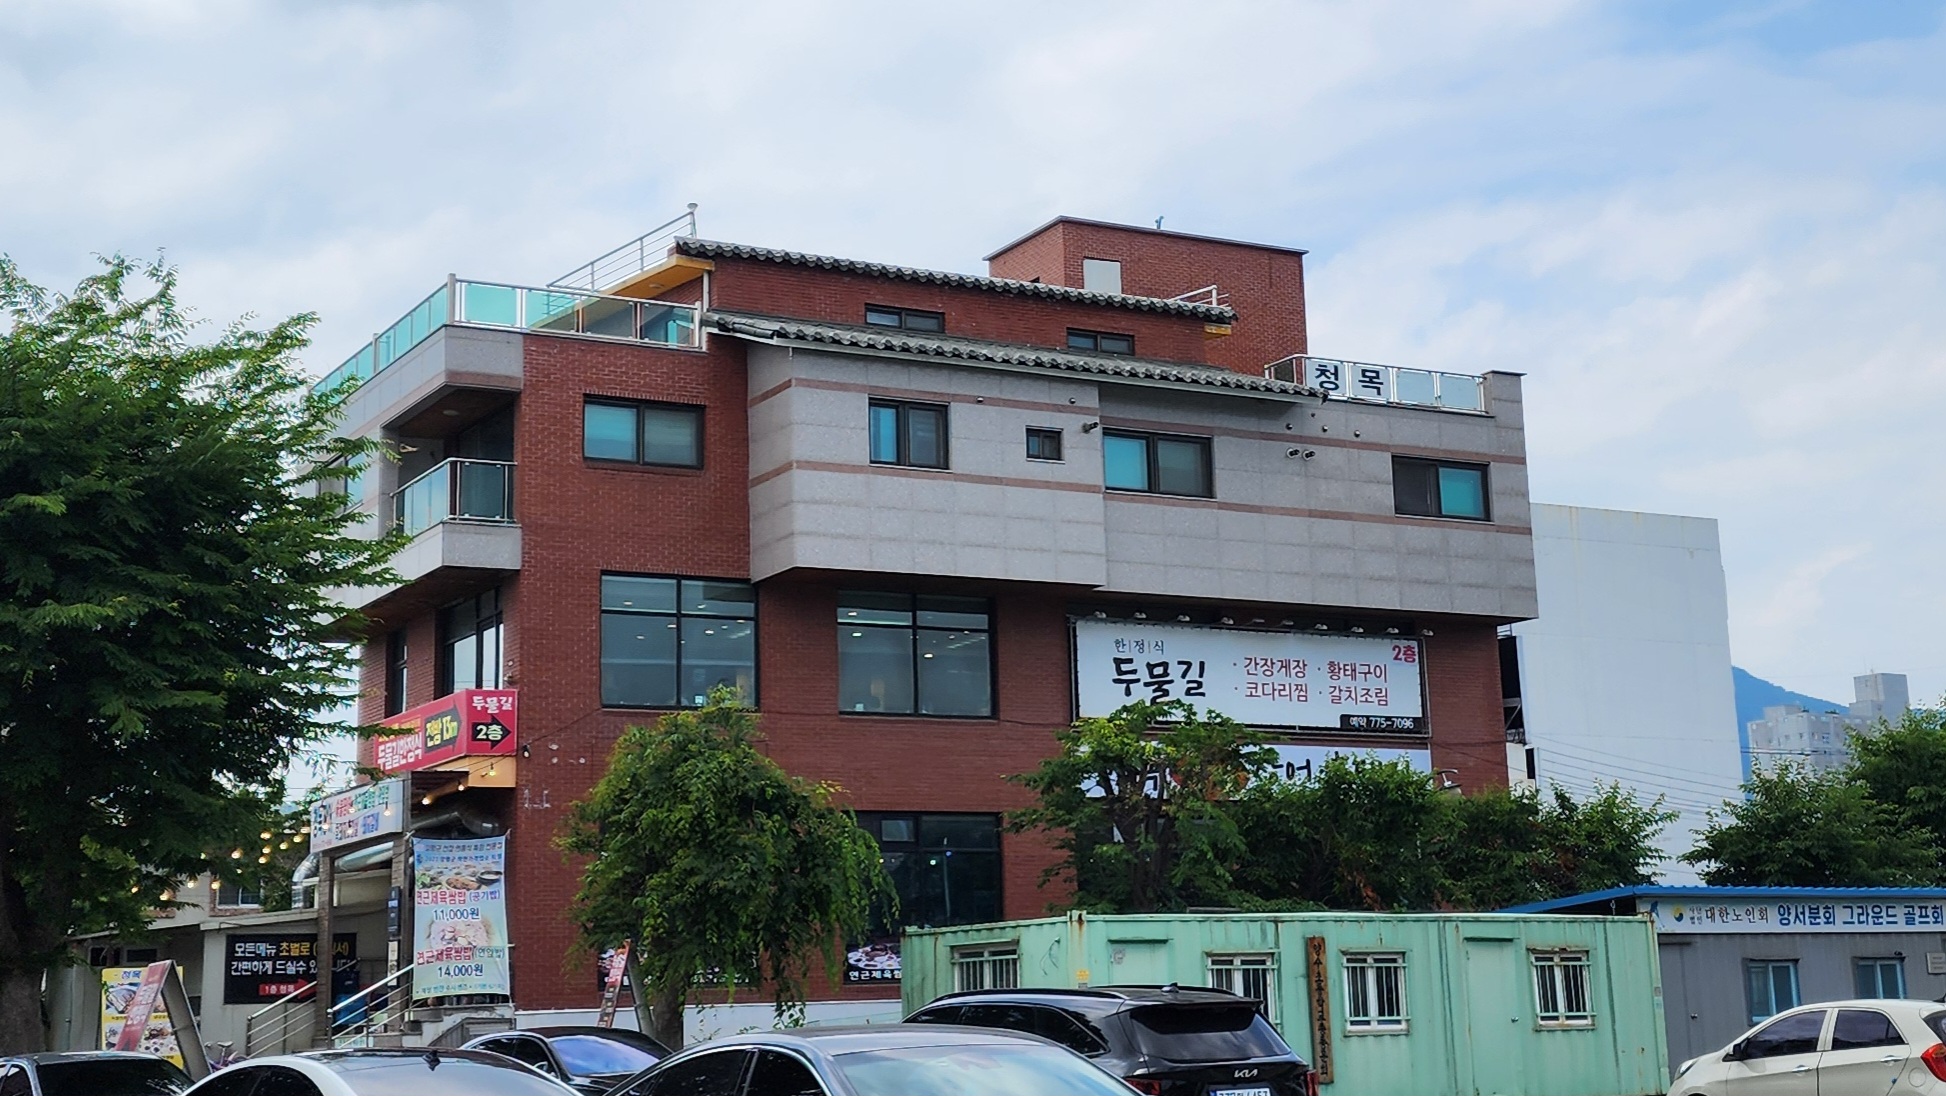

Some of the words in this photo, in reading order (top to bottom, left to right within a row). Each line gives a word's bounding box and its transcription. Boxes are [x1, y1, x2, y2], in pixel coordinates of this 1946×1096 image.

[1314, 364, 1383, 396] 청목
[1391, 644, 1417, 663] 2층
[1243, 656, 1308, 679] 간장게장
[1326, 660, 1388, 683] 황태구이
[1112, 657, 1206, 704] 두물길
[1245, 681, 1308, 702] 코다리찜
[1328, 684, 1388, 706] 갈치조림
[471, 695, 513, 714] 두물길
[1349, 716, 1367, 727] 예약
[1369, 717, 1414, 729] 775-7096
[476, 724, 503, 741] 2층
[434, 907, 480, 920] 11,000원
[1705, 905, 1769, 924] 대한노인회
[1777, 903, 1837, 926] 양서분회
[1841, 903, 1899, 925] 그라운드
[1902, 903, 1945, 925] 골프회
[234, 942, 277, 957] 모든메뉴
[279, 941, 311, 957] 초벌로
[231, 960, 273, 975] 간편하게
[275, 960, 307, 975] 드실수
[438, 963, 483, 978] 14,000원
[1233, 1068, 1258, 1077] KIA
